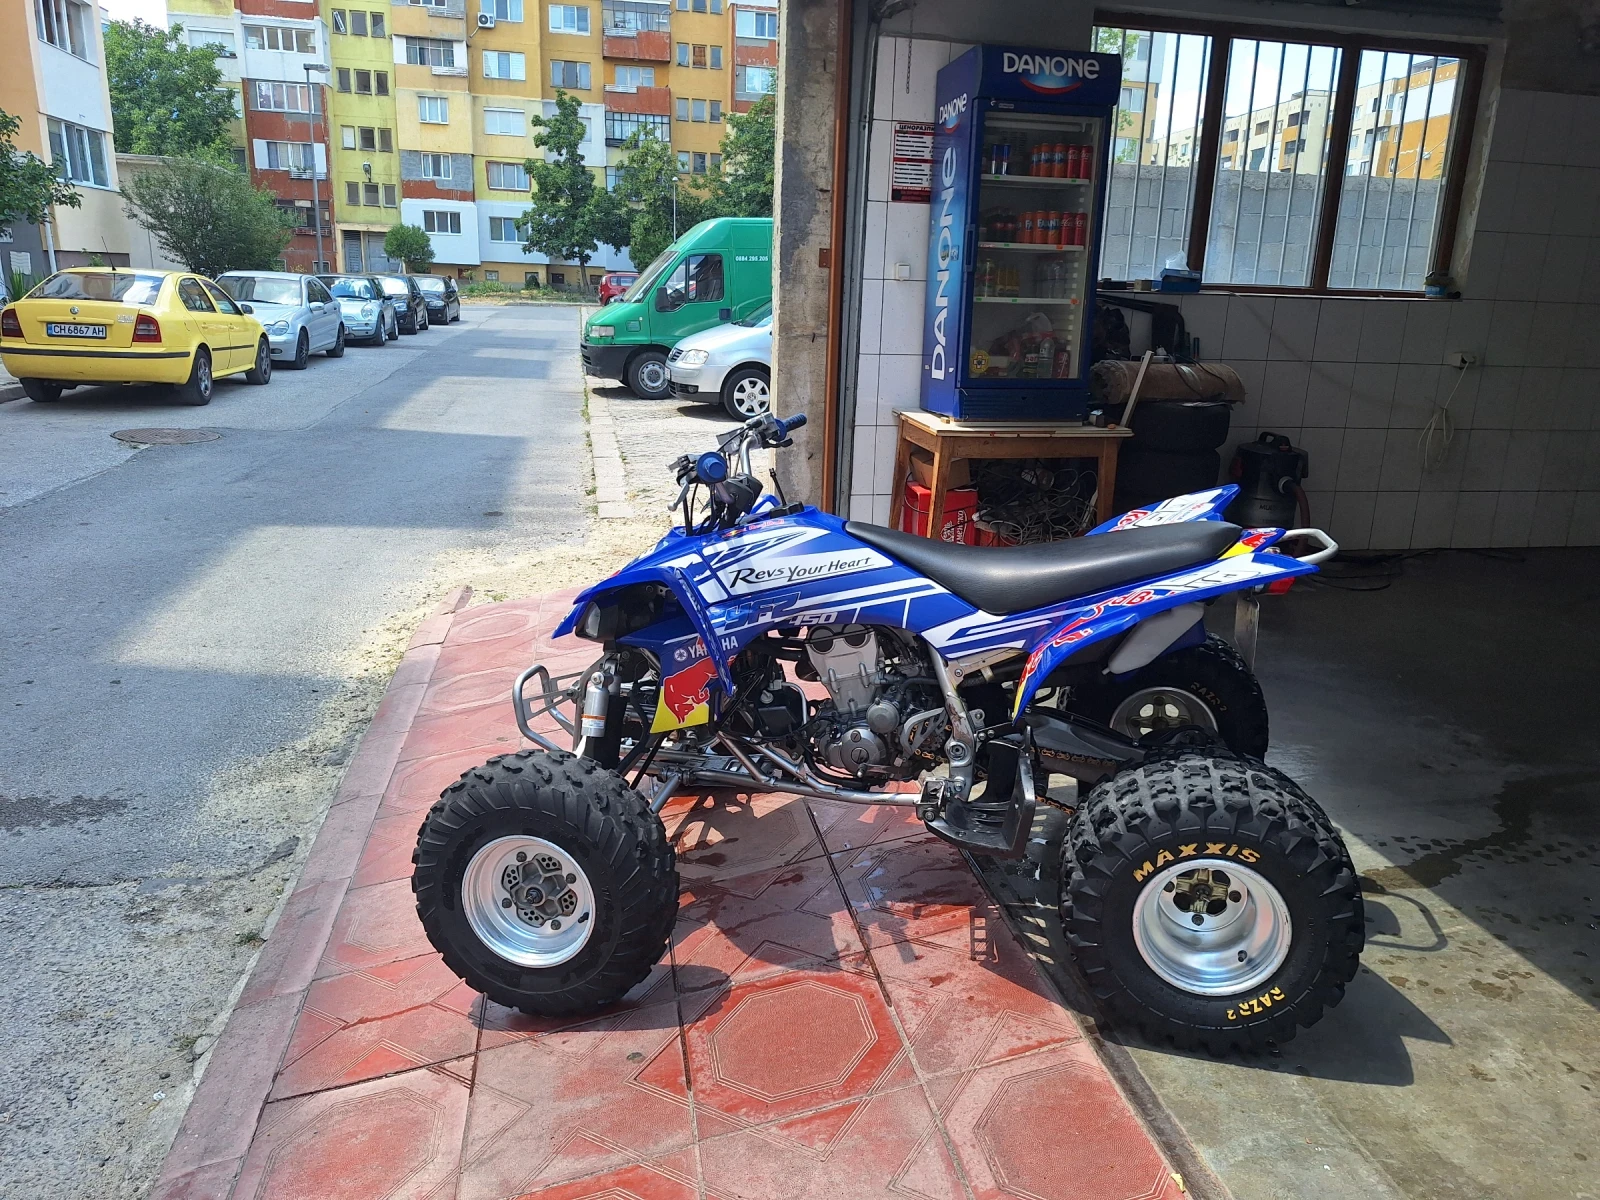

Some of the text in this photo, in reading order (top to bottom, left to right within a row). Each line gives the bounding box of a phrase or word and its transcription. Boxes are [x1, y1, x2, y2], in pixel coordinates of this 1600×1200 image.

[788, 612, 838, 626] 450
[1133, 842, 1261, 882] MAXXIS
[1226, 986, 1286, 1020] RAZR 2
